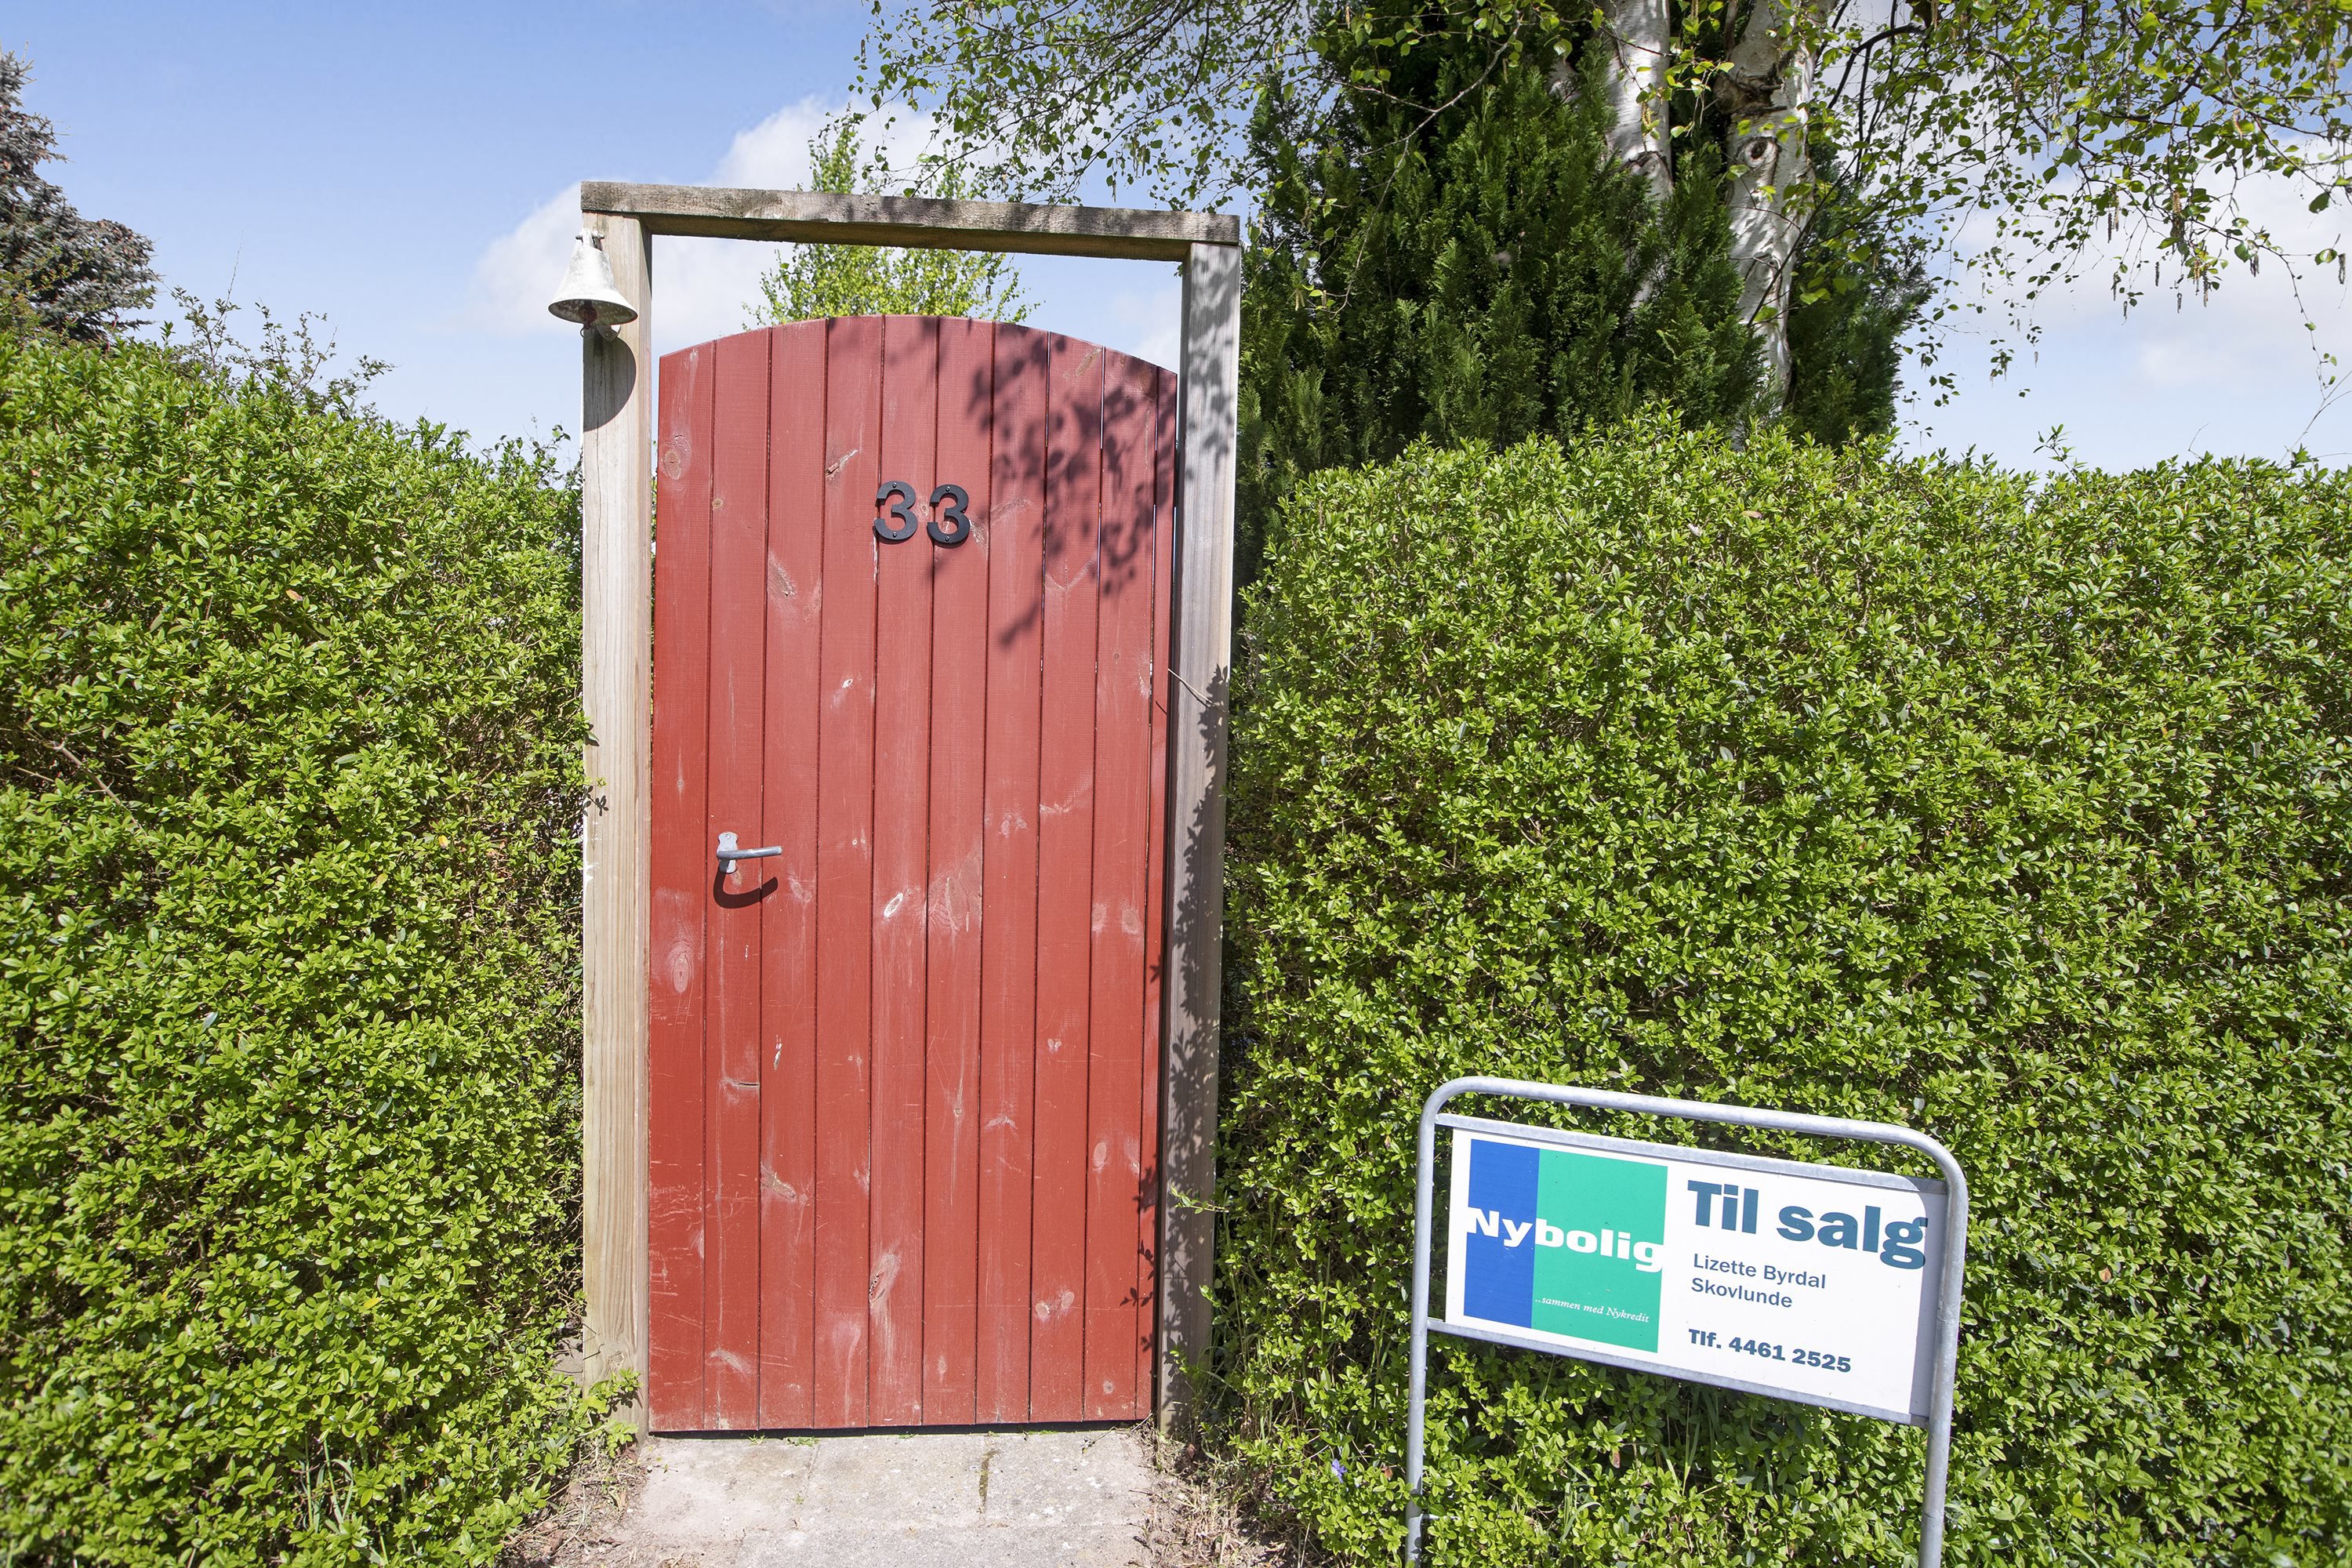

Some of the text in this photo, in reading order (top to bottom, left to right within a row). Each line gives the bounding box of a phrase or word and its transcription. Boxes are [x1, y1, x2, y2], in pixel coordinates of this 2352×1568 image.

[873, 480, 971, 544] 33
[1467, 1207, 1664, 1273] Nybolig
[1687, 1179, 1929, 1270] Til salg
[1691, 1277, 1793, 1308] Skovlunde
[1693, 1253, 1826, 1290] Lizette Byrdal
[1583, 1303, 1604, 1315] med
[1606, 1307, 1650, 1323] Nykredit
[1688, 1328, 1852, 1374] Tlf. 4461 2525
